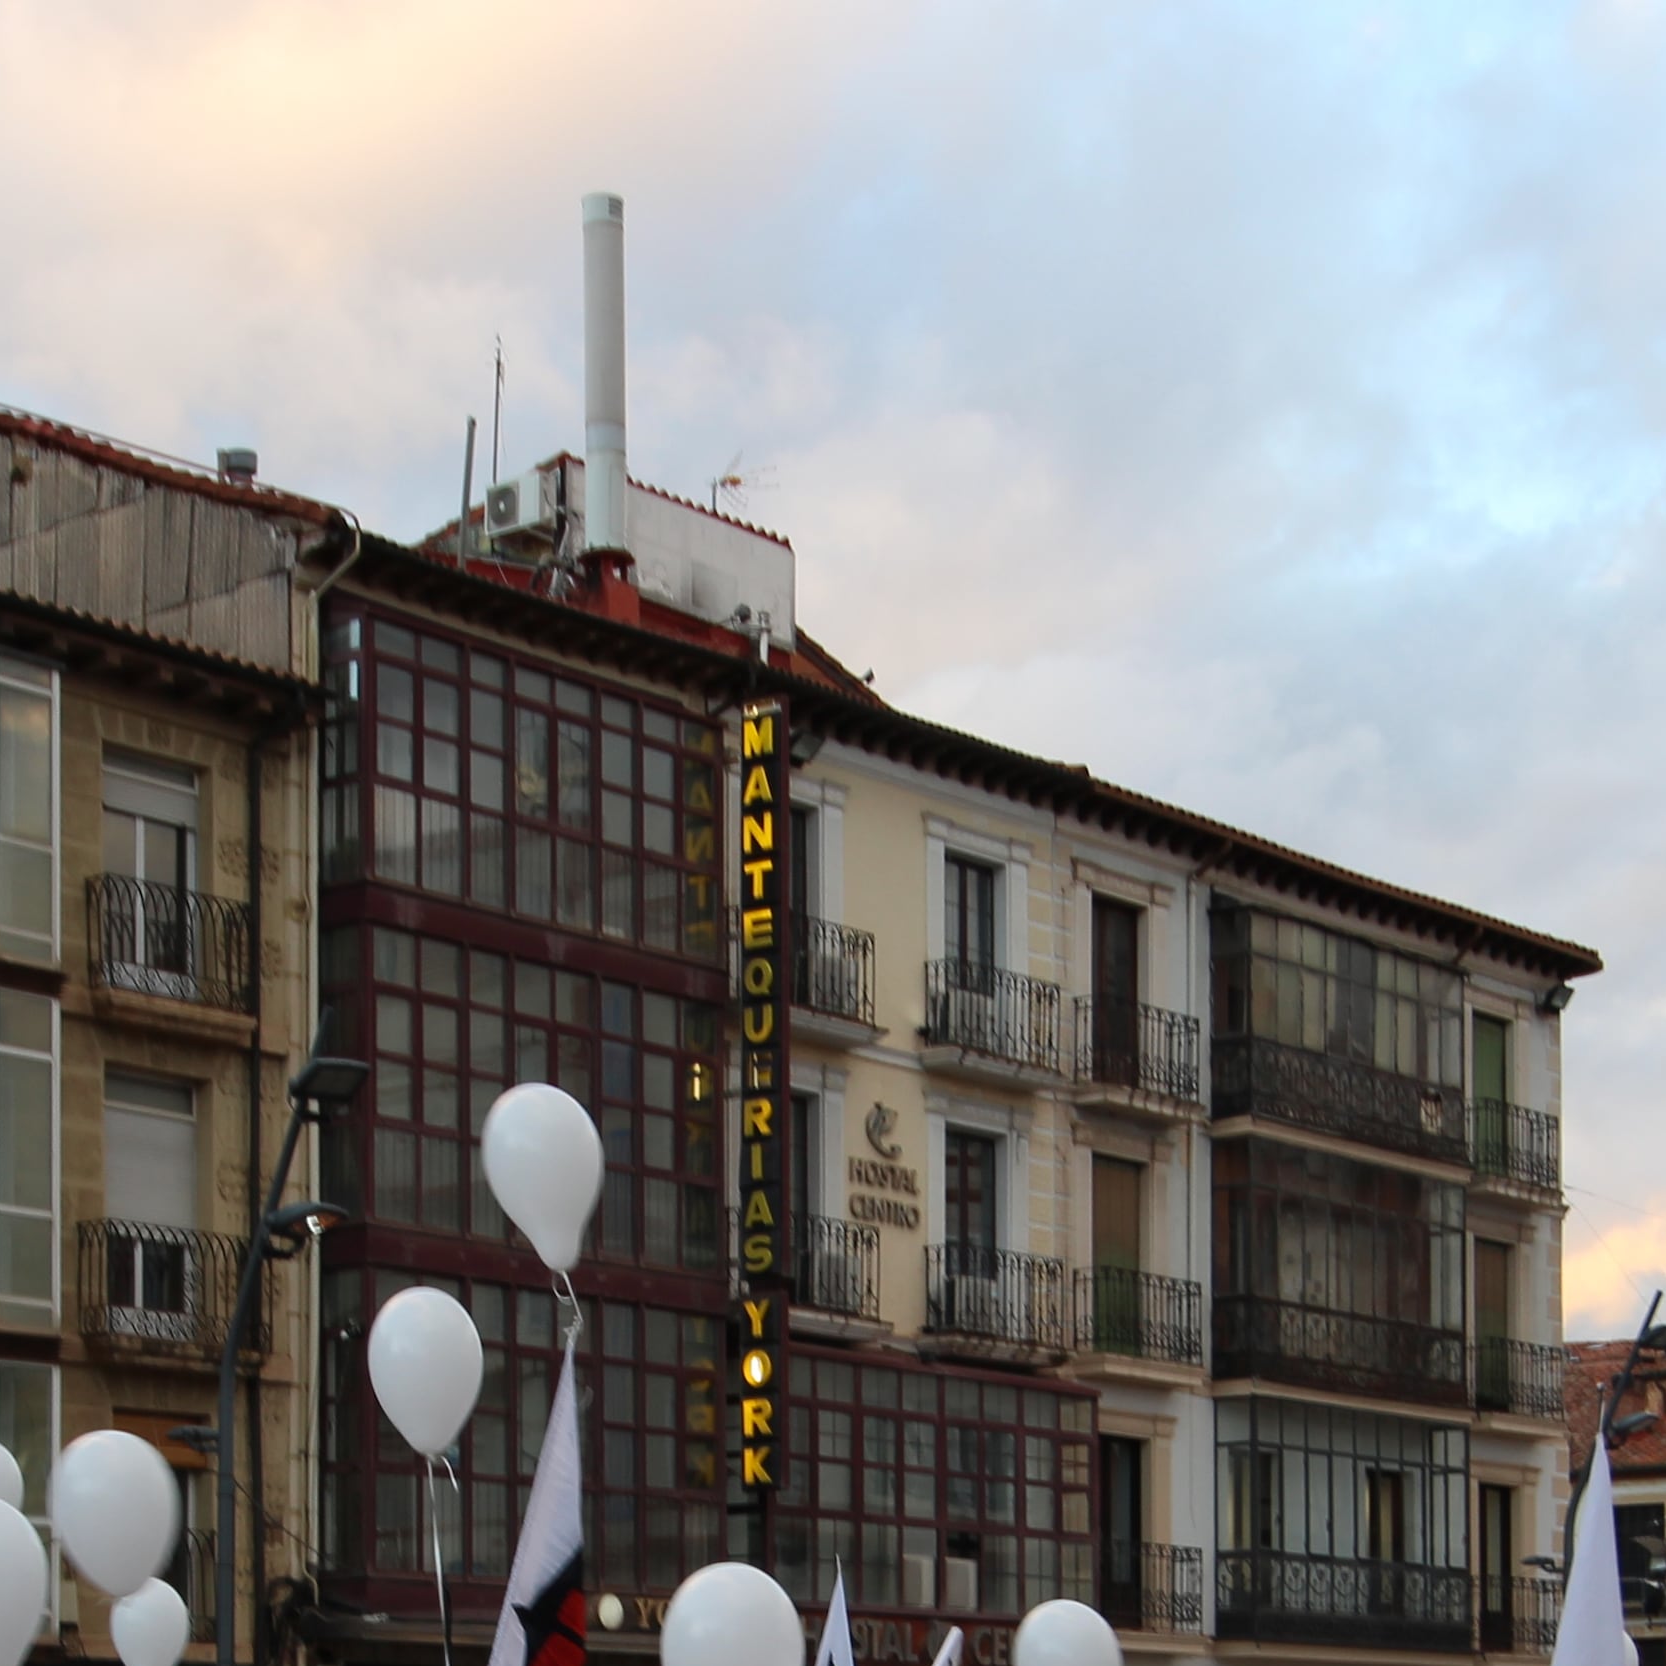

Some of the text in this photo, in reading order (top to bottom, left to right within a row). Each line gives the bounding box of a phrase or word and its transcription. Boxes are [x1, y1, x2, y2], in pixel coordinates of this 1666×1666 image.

[740, 714, 775, 1486] MANTEQUERIAS YORK
[848, 1156, 921, 1196] HOSTAL
[849, 1193, 921, 1230] CENTRO
[636, 1600, 667, 1630] YO
[802, 1613, 919, 1662] HSTAL
